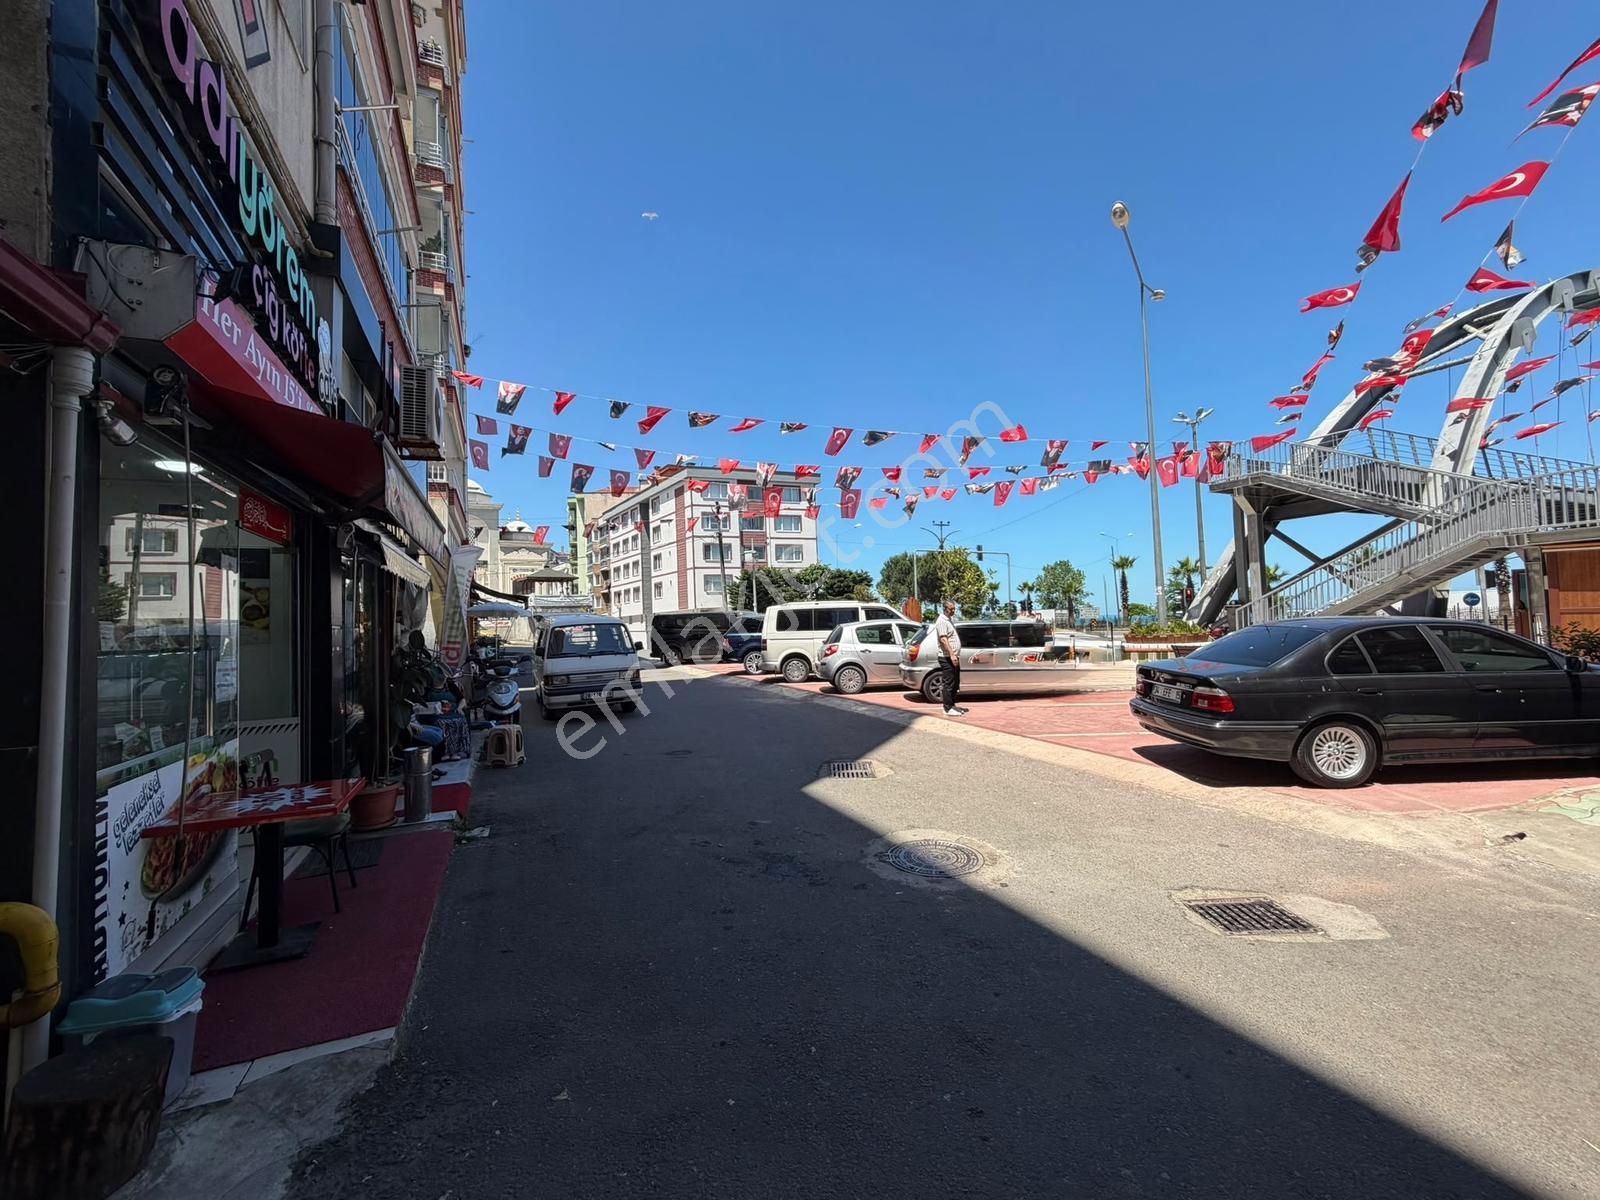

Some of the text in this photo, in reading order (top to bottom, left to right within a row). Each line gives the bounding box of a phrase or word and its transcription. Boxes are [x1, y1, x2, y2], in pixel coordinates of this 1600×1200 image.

[244, 334, 281, 392] Ayın
[252, 263, 316, 389] çiğ köfte
